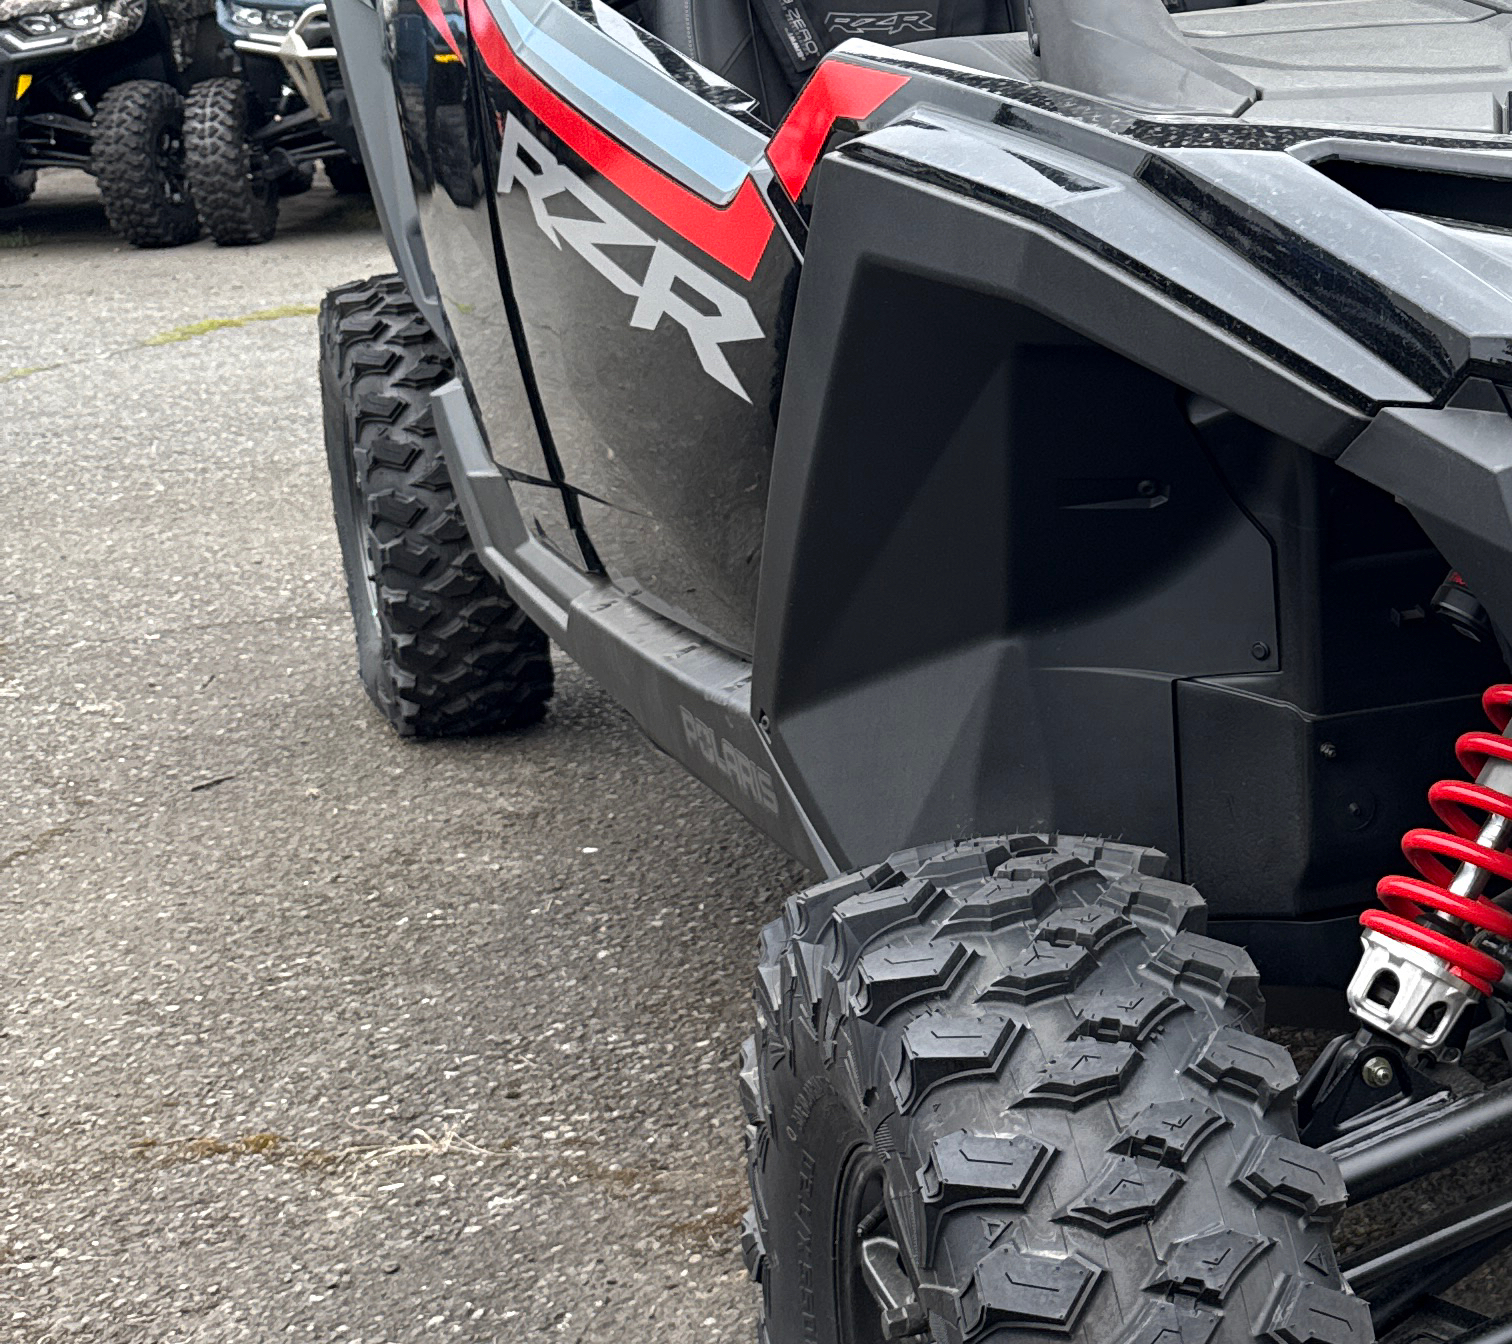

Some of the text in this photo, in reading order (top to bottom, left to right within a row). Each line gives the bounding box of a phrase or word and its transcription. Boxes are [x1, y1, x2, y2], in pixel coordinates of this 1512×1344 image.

[785, 6, 819, 55] ZERO
[823, 10, 937, 35] RZR
[497, 110, 766, 406] RZR
[679, 704, 779, 816] POLARIS
